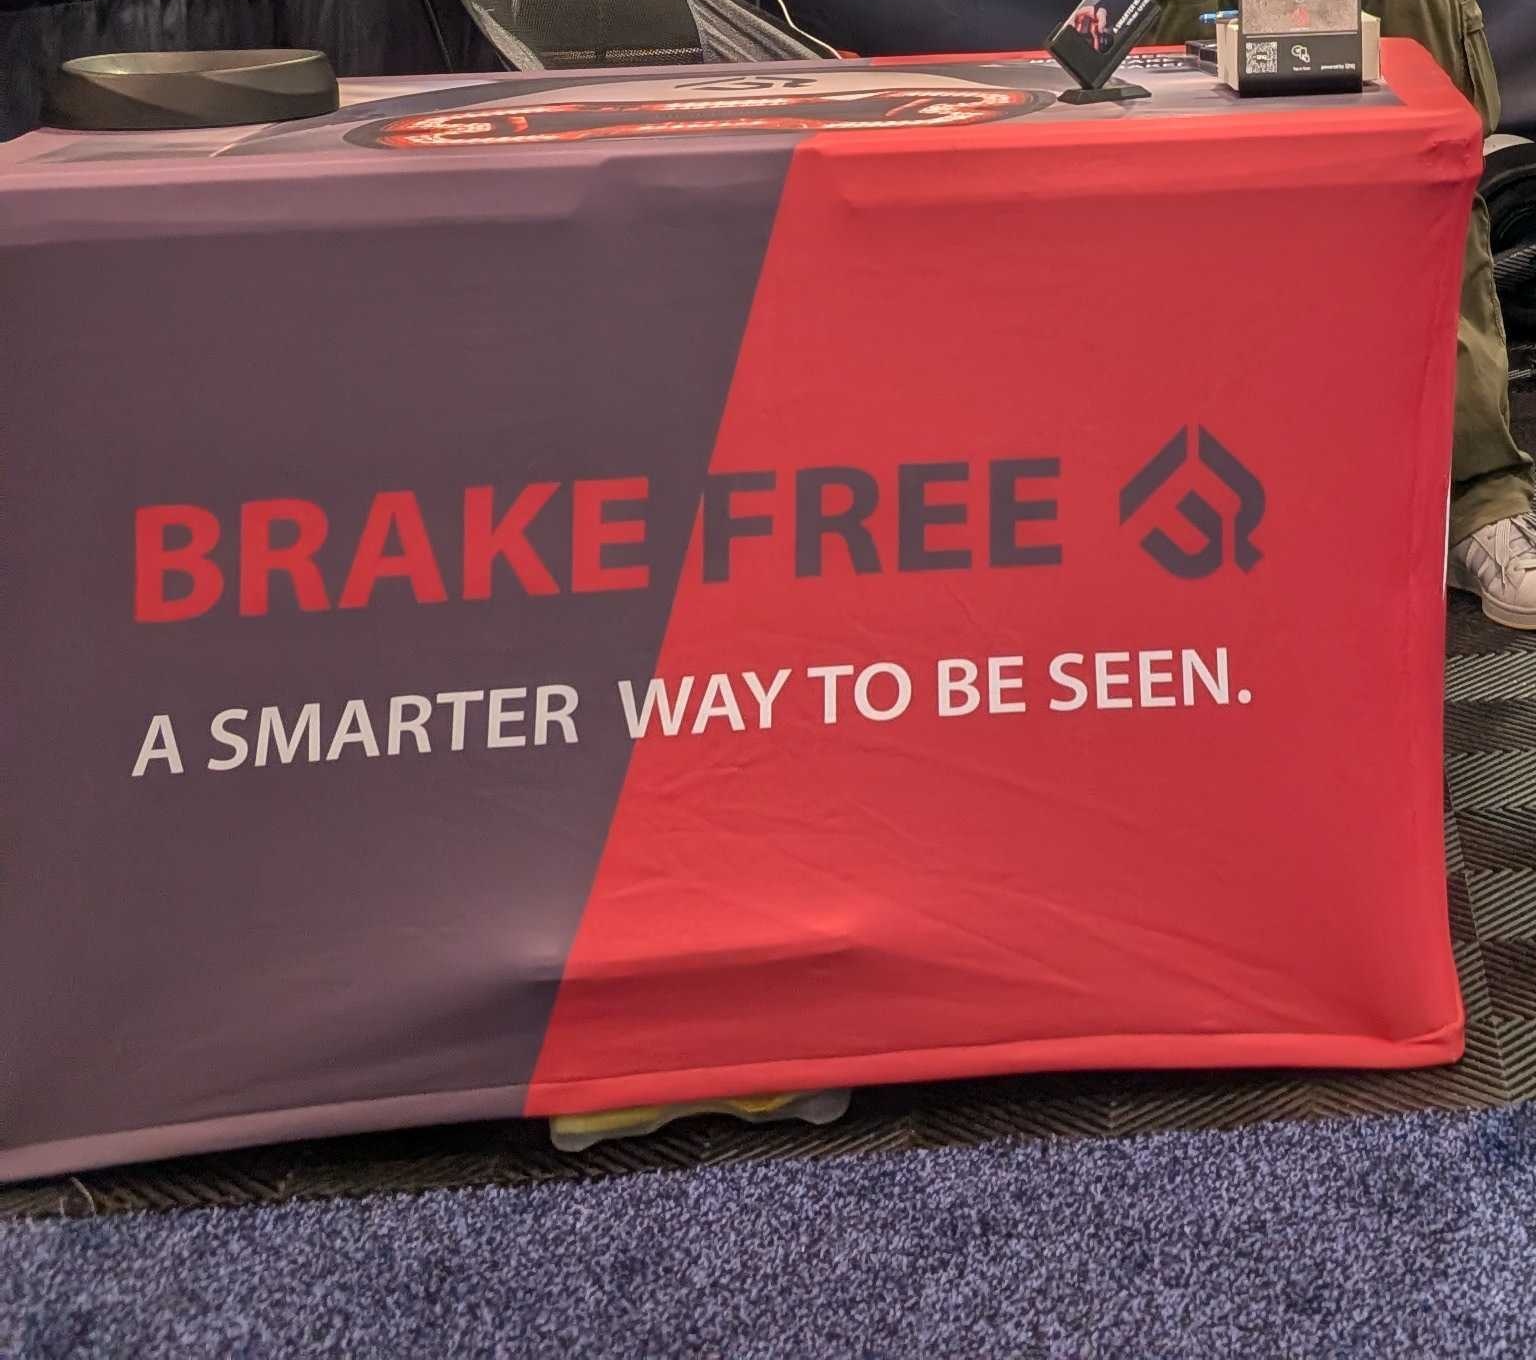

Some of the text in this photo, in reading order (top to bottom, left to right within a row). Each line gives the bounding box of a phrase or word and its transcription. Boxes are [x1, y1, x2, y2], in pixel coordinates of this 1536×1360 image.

[134, 457, 1063, 625] BRAKE FREE
[131, 647, 1252, 777] A SMARTER WAY TO BE SEEN.
